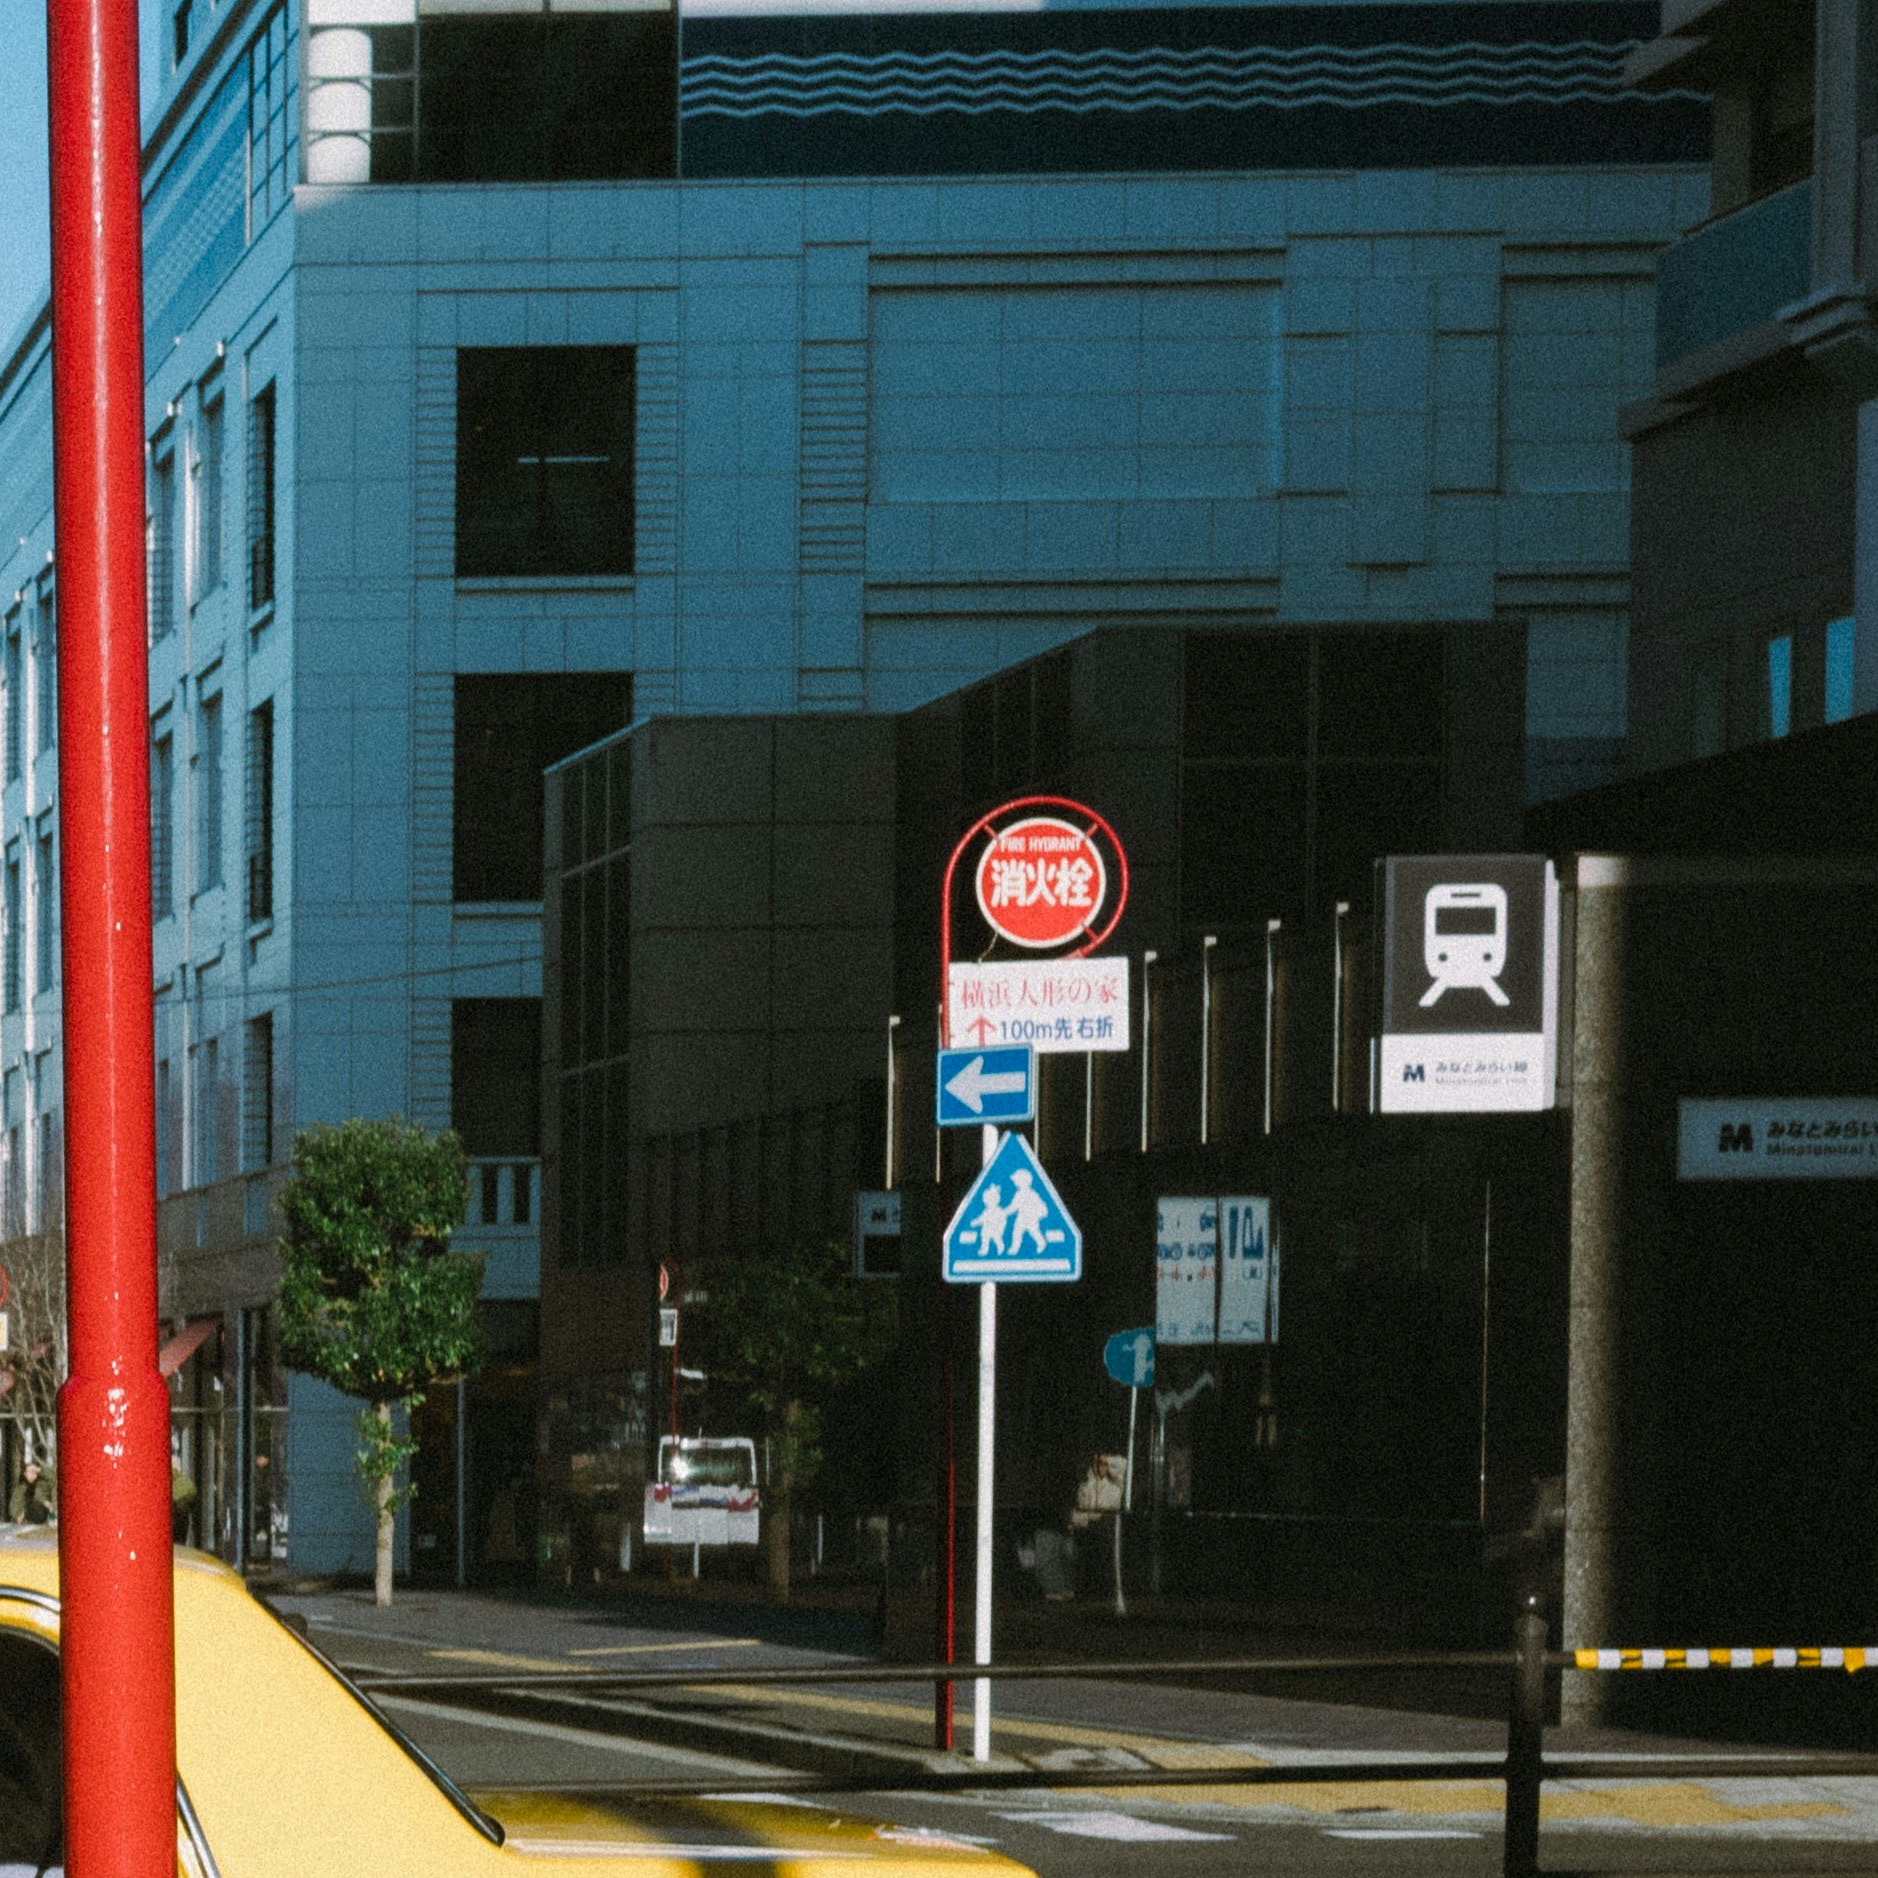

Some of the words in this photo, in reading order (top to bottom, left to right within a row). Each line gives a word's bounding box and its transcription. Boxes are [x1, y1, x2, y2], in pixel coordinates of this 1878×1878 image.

[1000, 837, 1025, 852] FIRE
[1029, 837, 1081, 851] HYDRANT
[991, 858, 1093, 907] 消火栓
[962, 976, 1118, 1010] 横浜人形の家
